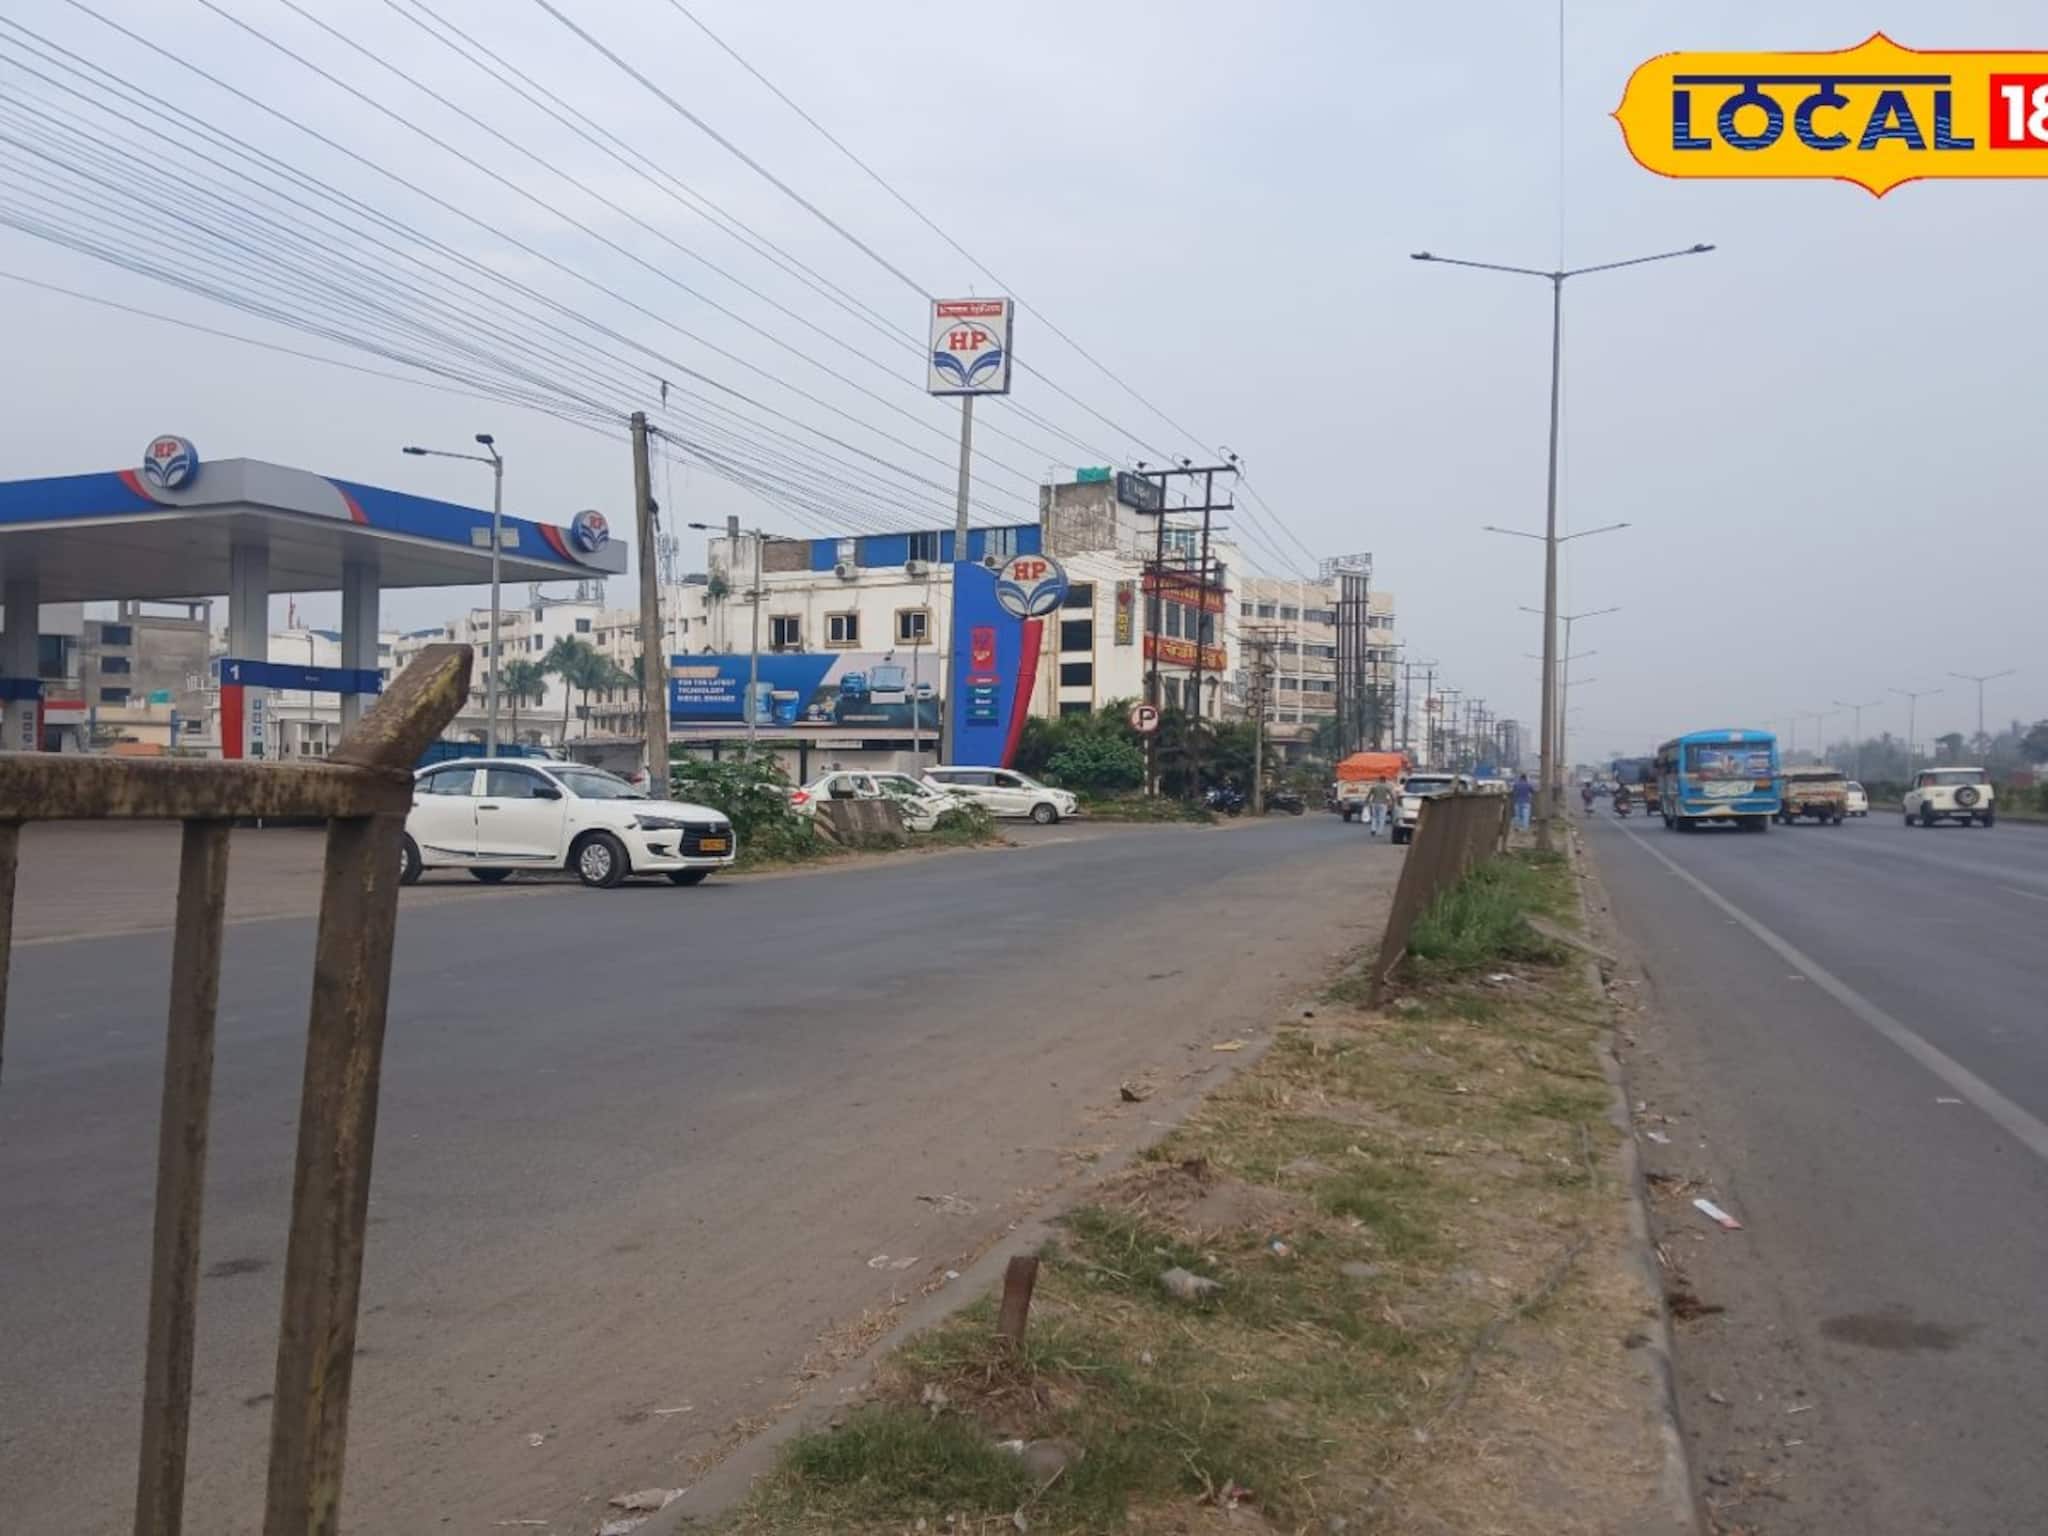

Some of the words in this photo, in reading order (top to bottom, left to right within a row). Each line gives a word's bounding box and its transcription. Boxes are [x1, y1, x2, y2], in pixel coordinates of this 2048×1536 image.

[949, 331, 986, 350] HP
[154, 442, 177, 458] HP
[1014, 561, 1047, 580] HP
[229, 664, 240, 680] 1
[1139, 708, 1156, 728] P
